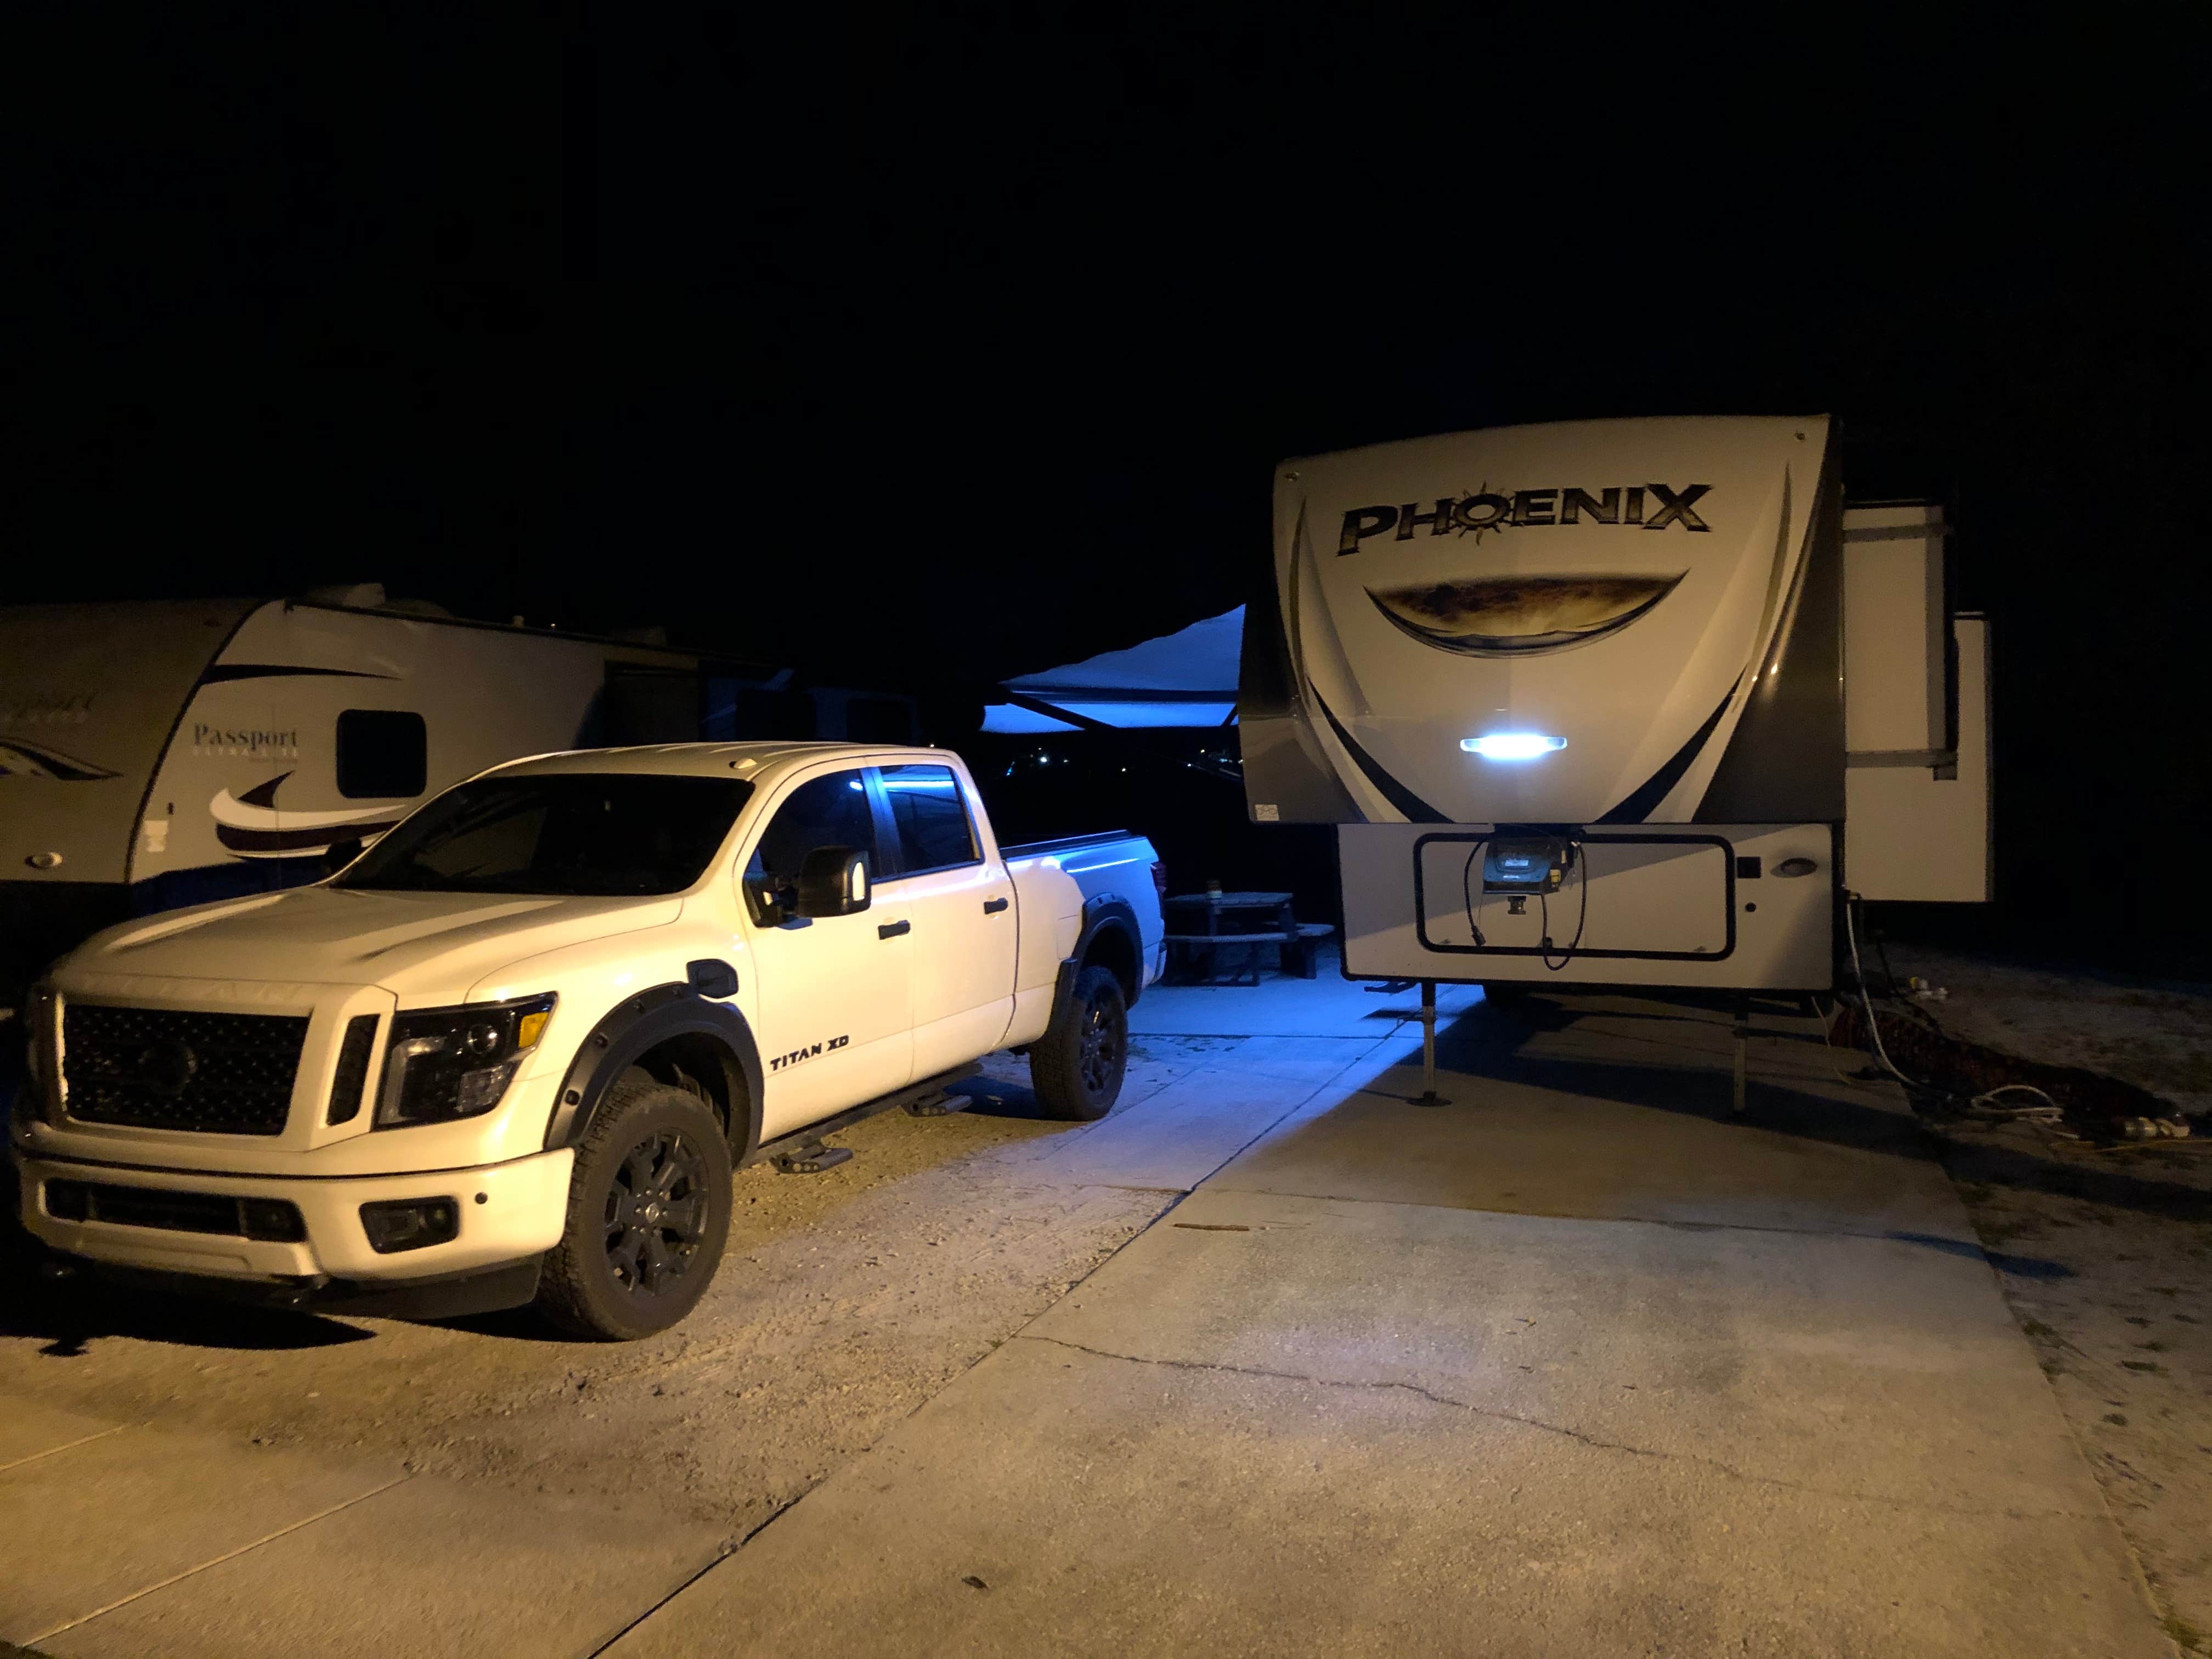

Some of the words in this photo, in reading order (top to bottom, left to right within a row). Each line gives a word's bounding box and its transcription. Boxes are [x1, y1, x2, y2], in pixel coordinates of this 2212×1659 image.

[1336, 483, 1714, 556] PHOENIX
[194, 723, 297, 751] Passport
[770, 1042, 822, 1071] TITAN
[826, 1035, 849, 1052] XD
